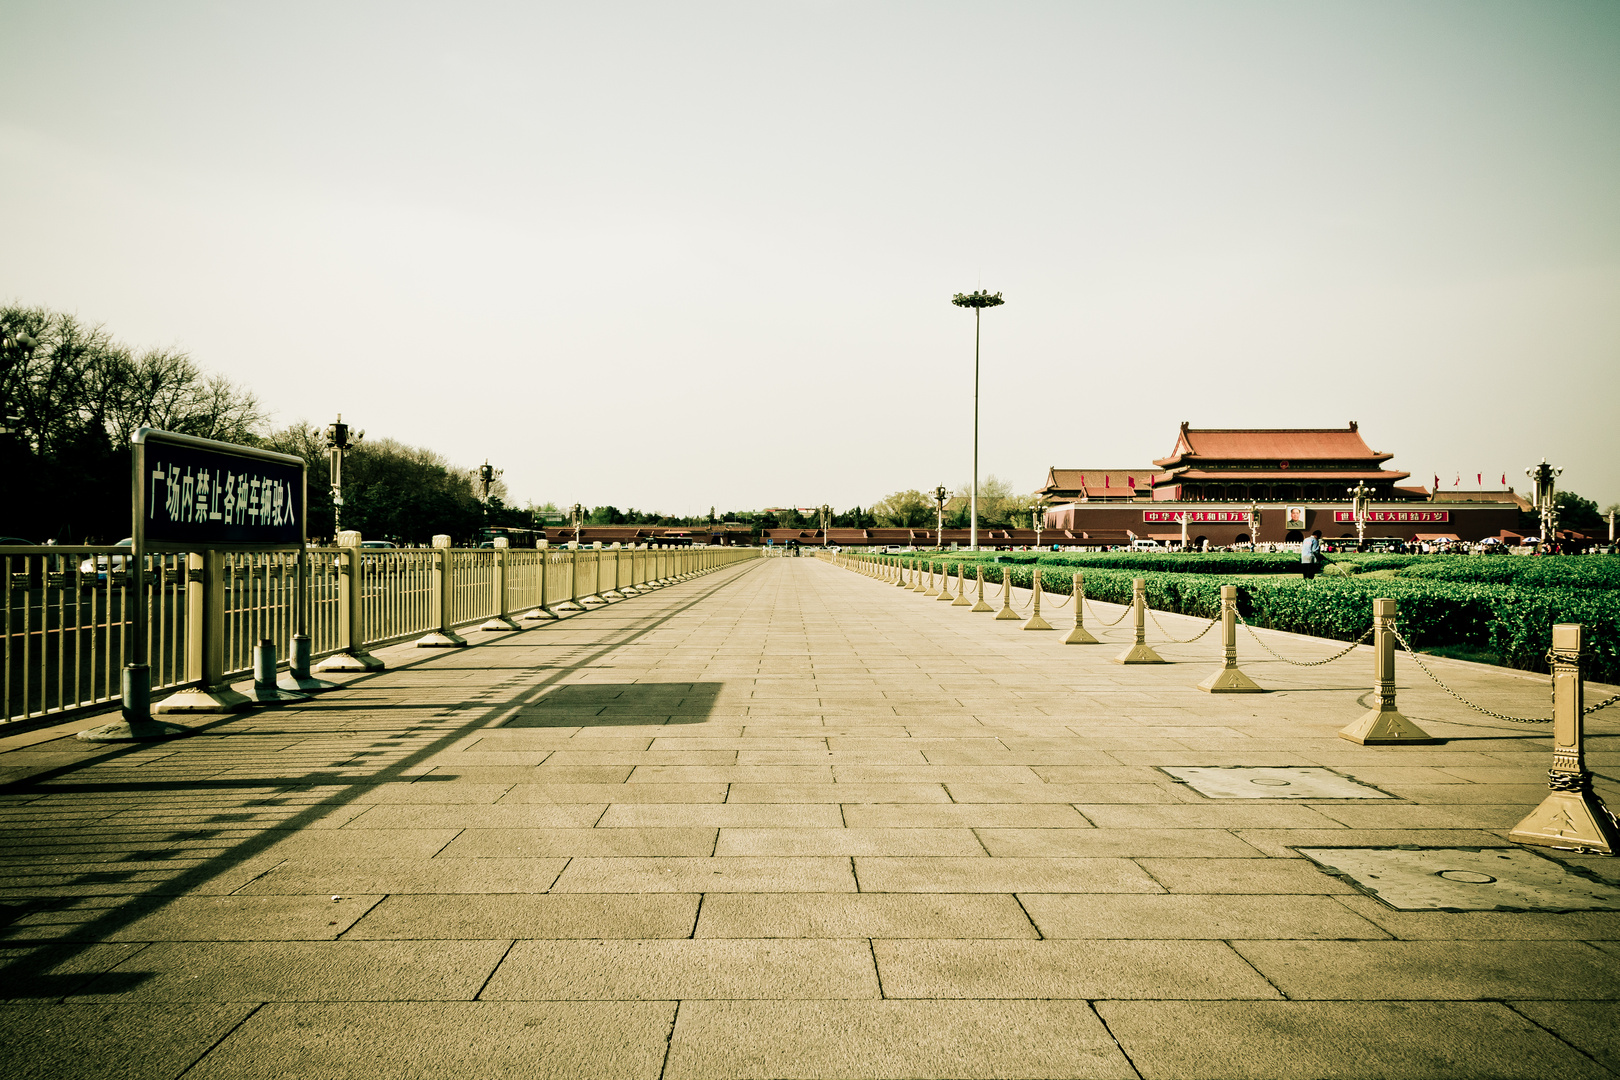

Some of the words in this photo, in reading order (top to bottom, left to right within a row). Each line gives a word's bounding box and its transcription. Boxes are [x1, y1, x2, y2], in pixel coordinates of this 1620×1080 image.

[150, 461, 295, 527] 广场内禁止各种车辆驶入
